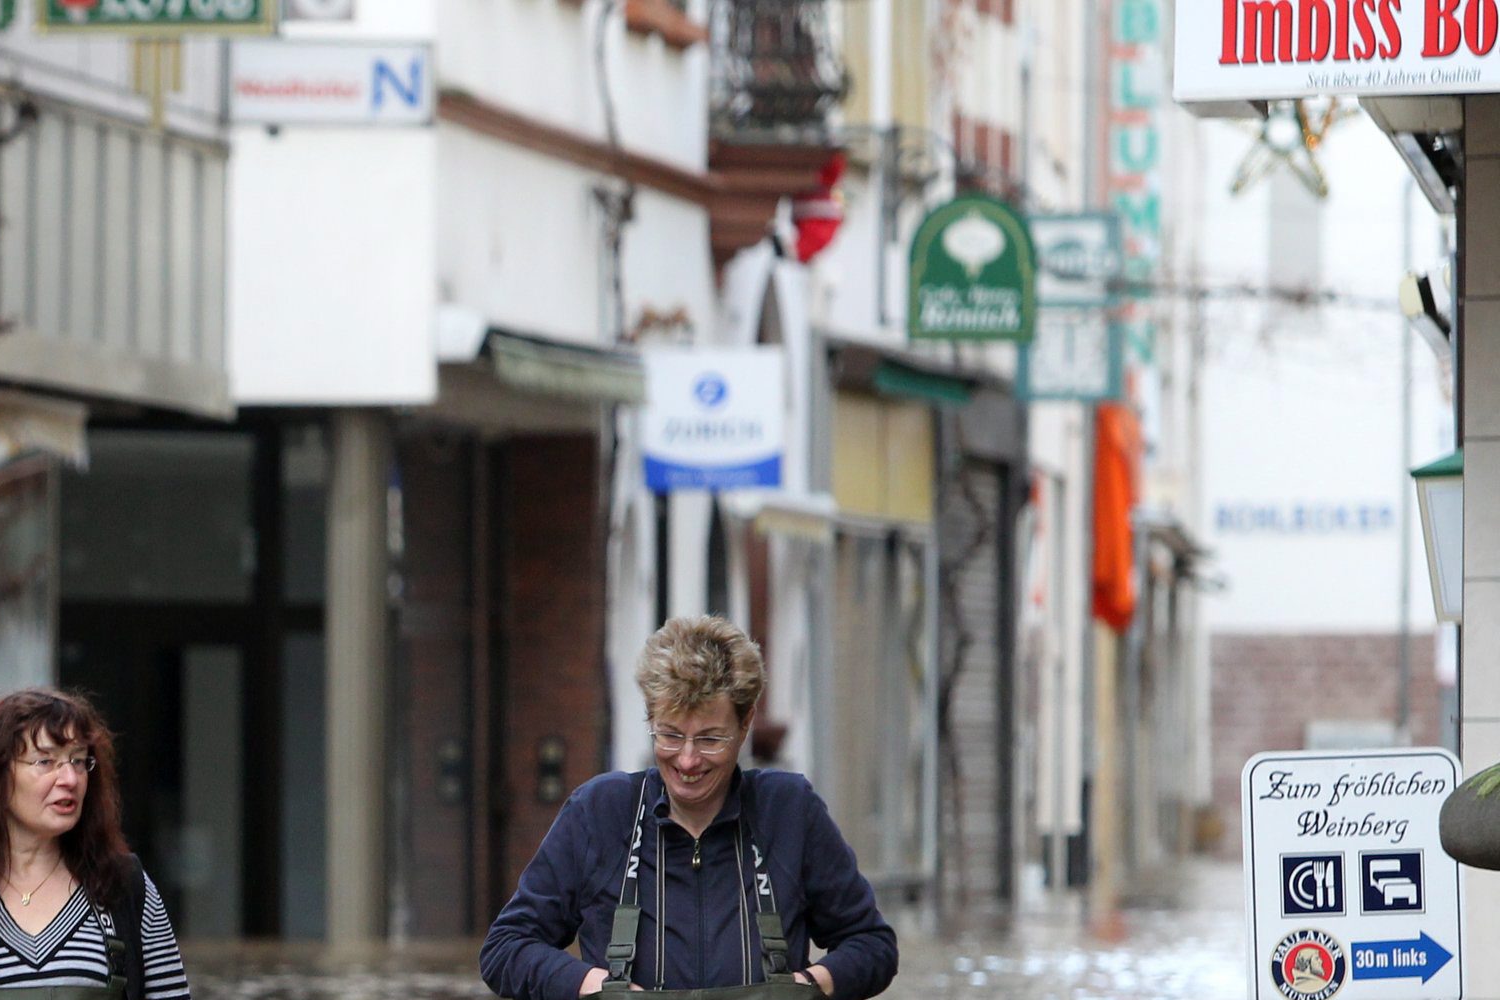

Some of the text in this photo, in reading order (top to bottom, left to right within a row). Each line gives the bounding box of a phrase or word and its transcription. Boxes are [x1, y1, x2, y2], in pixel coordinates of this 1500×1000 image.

[1219, 0, 1402, 64] Imbiss
[1306, 72, 1328, 89] Seit
[1332, 70, 1360, 89] über
[1364, 70, 1381, 86] 40
[1383, 68, 1426, 86] Jahren
[1259, 770, 1447, 807] Zum fröhlichen
[1297, 809, 1410, 844] Weinberg
[1272, 930, 1343, 962] PAULANER
[1356, 948, 1428, 969] 30 m links
